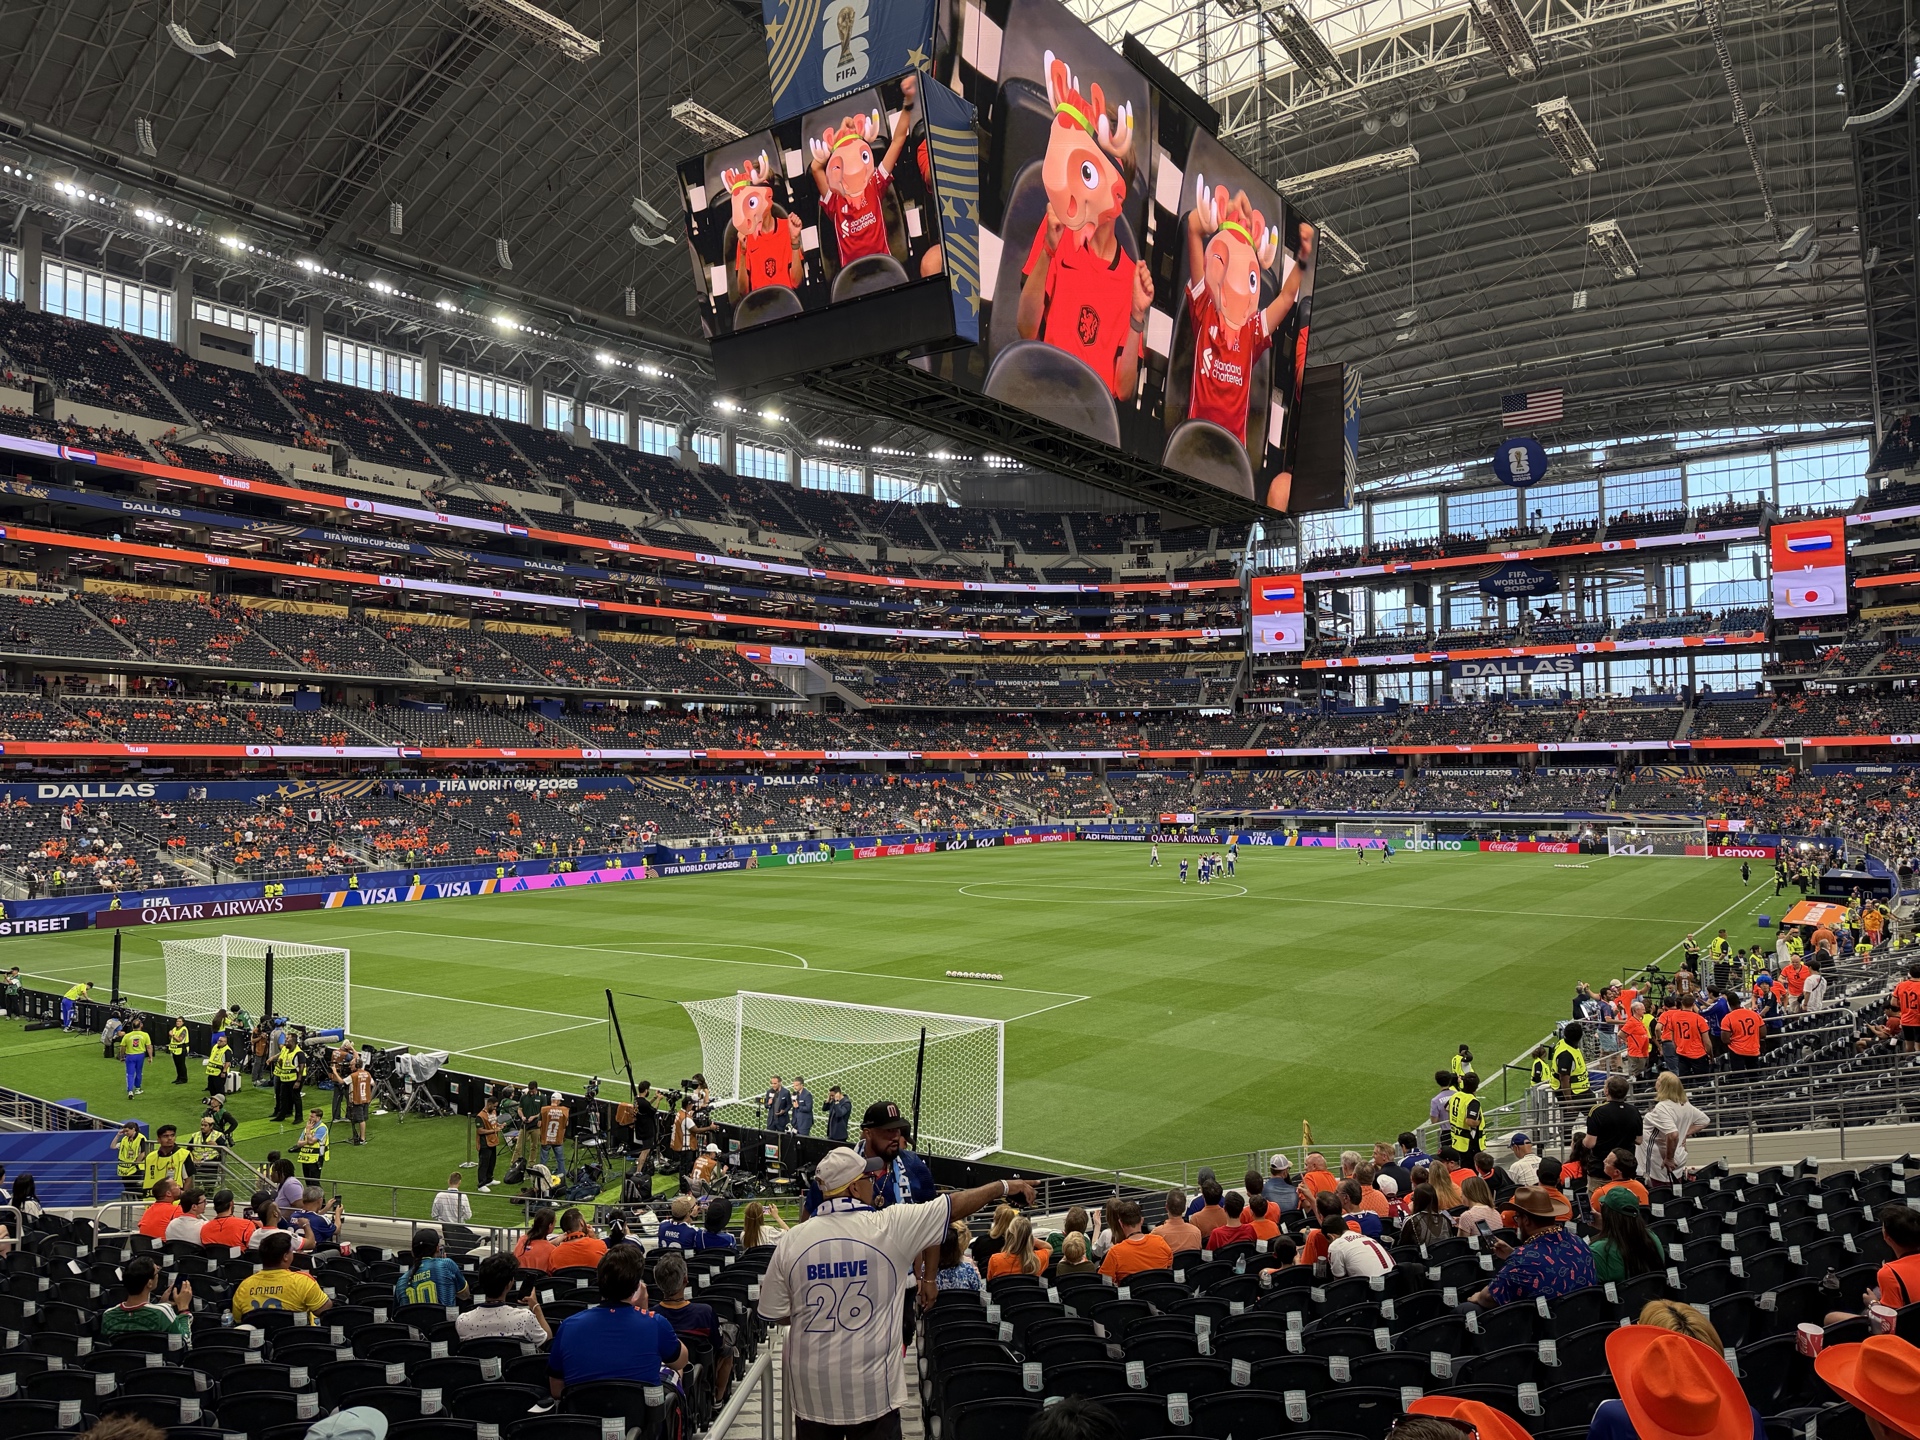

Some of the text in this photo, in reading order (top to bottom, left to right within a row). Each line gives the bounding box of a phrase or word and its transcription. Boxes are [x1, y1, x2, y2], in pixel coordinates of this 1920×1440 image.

[836, 66, 857, 83] FIFA
[1213, 358, 1242, 375] standard
[1211, 369, 1243, 386] chartered
[122, 502, 181, 517] DALLAS
[323, 532, 410, 551] FIFA WORLD CUP 2026
[524, 560, 564, 572] DALLAS
[1493, 576, 1545, 587] WORLD CUP
[1508, 571, 1528, 579] FIFA
[1503, 584, 1535, 593] 2026
[850, 600, 879, 608] DALLAS
[1461, 658, 1575, 677] DALLAS
[1855, 766, 1892, 774] #FIFAWorldCup
[439, 780, 466, 792] FIFA
[538, 779, 578, 790] 2026
[763, 776, 818, 787] DALLAS
[38, 783, 156, 799] DALLAS
[1013, 836, 1032, 845] Lenovo
[1040, 834, 1063, 842] Lenovo
[1151, 834, 1219, 844] QATAR AIRWAYS
[1247, 836, 1274, 846] VISA
[787, 852, 828, 865] aramco
[1717, 846, 1766, 858] Lenovo
[664, 860, 738, 875] FIFA WORLD CUP 2026
[360, 887, 397, 904] VISA
[436, 882, 472, 898] VISA
[142, 897, 171, 908] FIFA
[143, 897, 284, 926] QATAR AIRWAYS
[1903, 990, 1918, 1009] 12
[1676, 1021, 1691, 1040] 12
[1738, 1017, 1755, 1037] 12
[806, 1259, 868, 1281] BELIEVE
[405, 1281, 437, 1305] 10
[804, 1280, 874, 1332] 26
